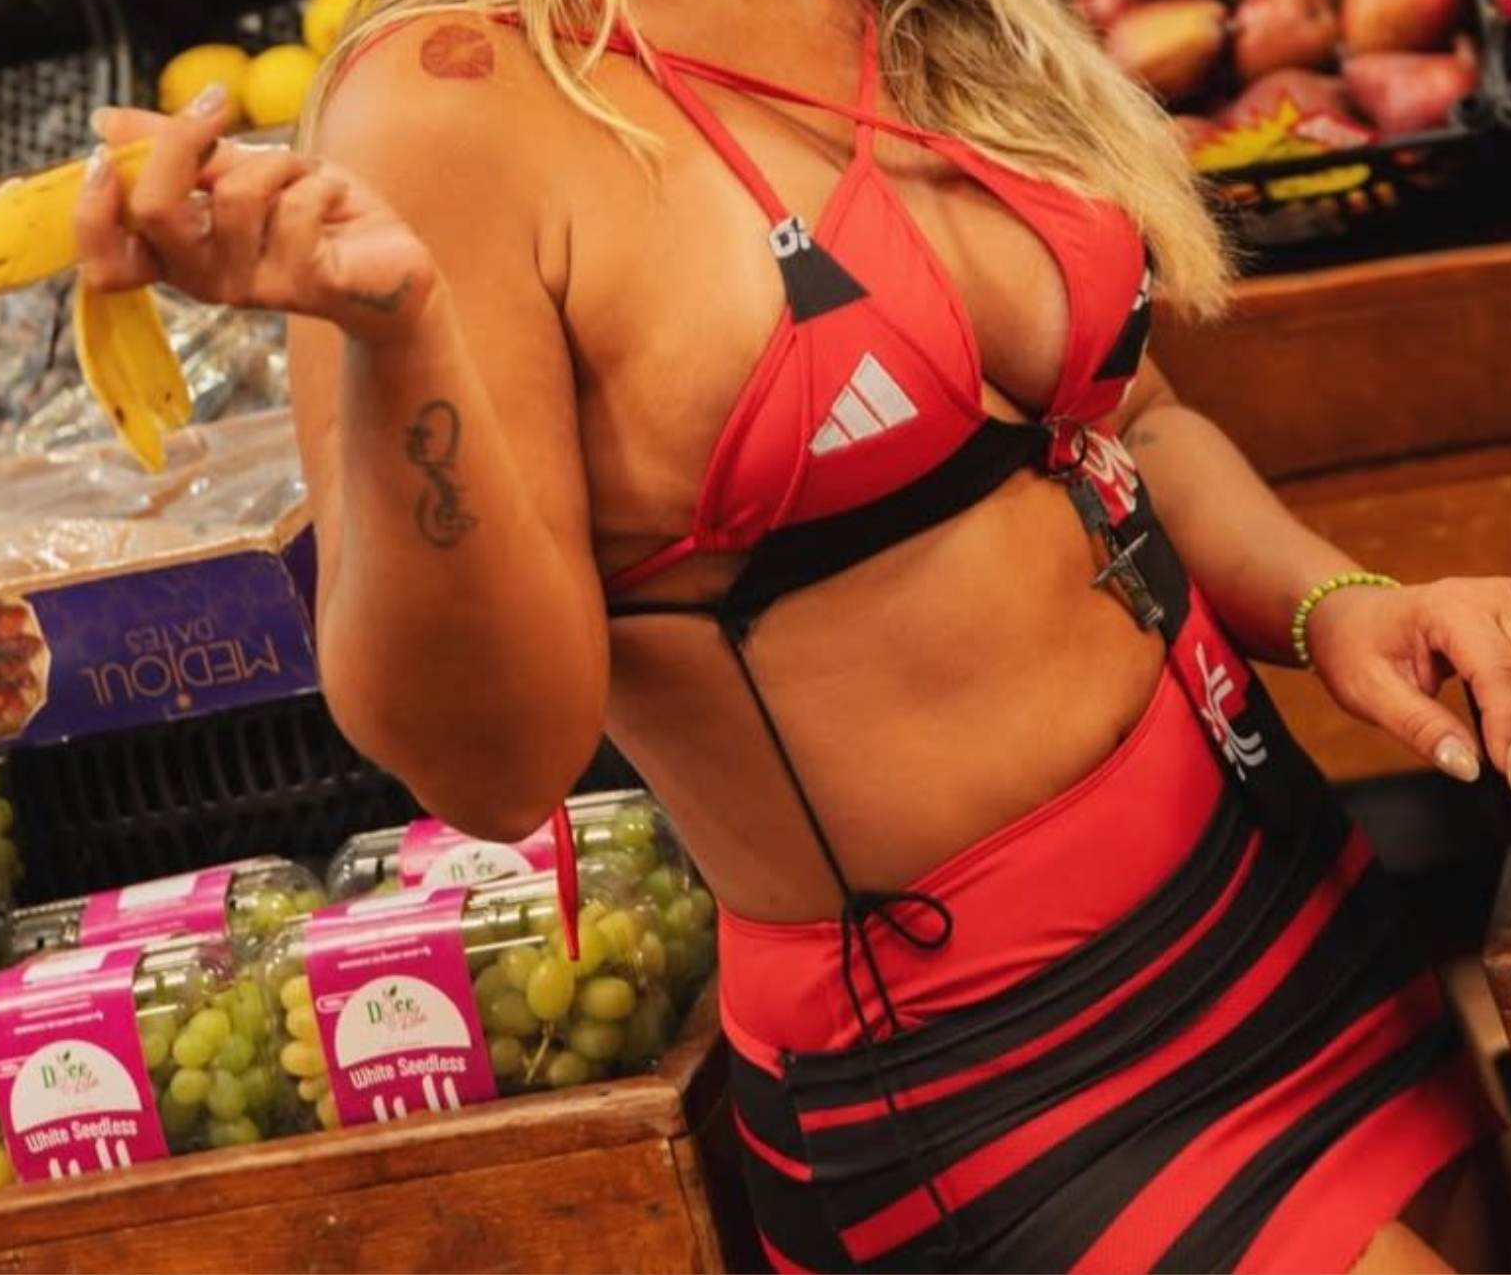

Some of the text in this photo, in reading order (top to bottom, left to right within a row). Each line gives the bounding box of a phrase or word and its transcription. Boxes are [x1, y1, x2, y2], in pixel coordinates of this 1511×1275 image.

[349, 1053, 466, 1090] White Seedless
[25, 1117, 137, 1153] White Seedless
